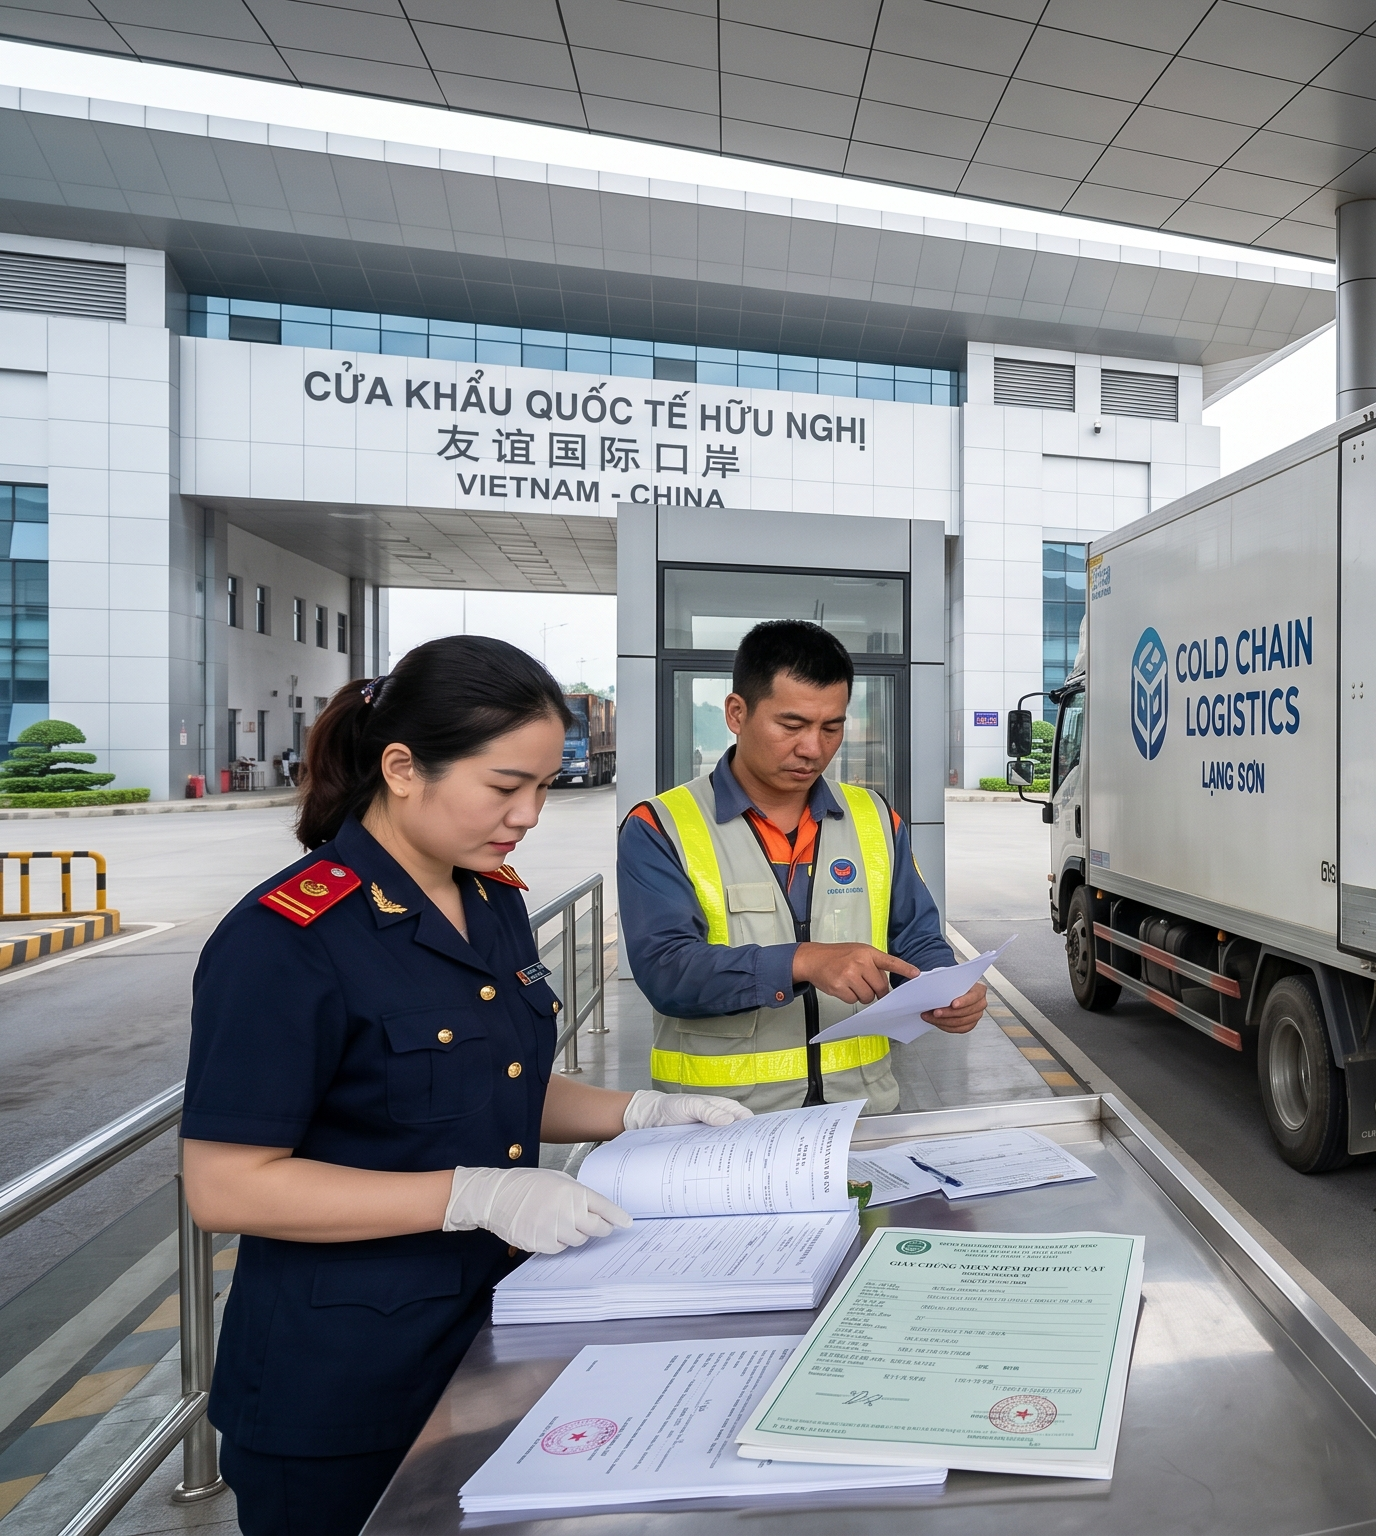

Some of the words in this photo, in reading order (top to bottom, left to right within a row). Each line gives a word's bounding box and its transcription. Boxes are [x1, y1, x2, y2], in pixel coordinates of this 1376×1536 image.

[304, 361, 393, 406] CỬA
[405, 369, 512, 416] KHẨU
[526, 382, 632, 425] QUỐC
[644, 391, 690, 429] TẾ
[700, 398, 773, 437] HỮU
[786, 411, 866, 451] NGHỊ
[436, 424, 740, 479] 友谊国际口岸
[457, 473, 599, 503] VIETNAM
[630, 484, 725, 508] CHINA
[1175, 636, 1229, 683] COLD
[1235, 616, 1312, 675] CHAIN
[1186, 685, 1300, 737] LOGISTICS
[1202, 761, 1234, 796] LẠNG
[1237, 759, 1265, 794] SƠN
